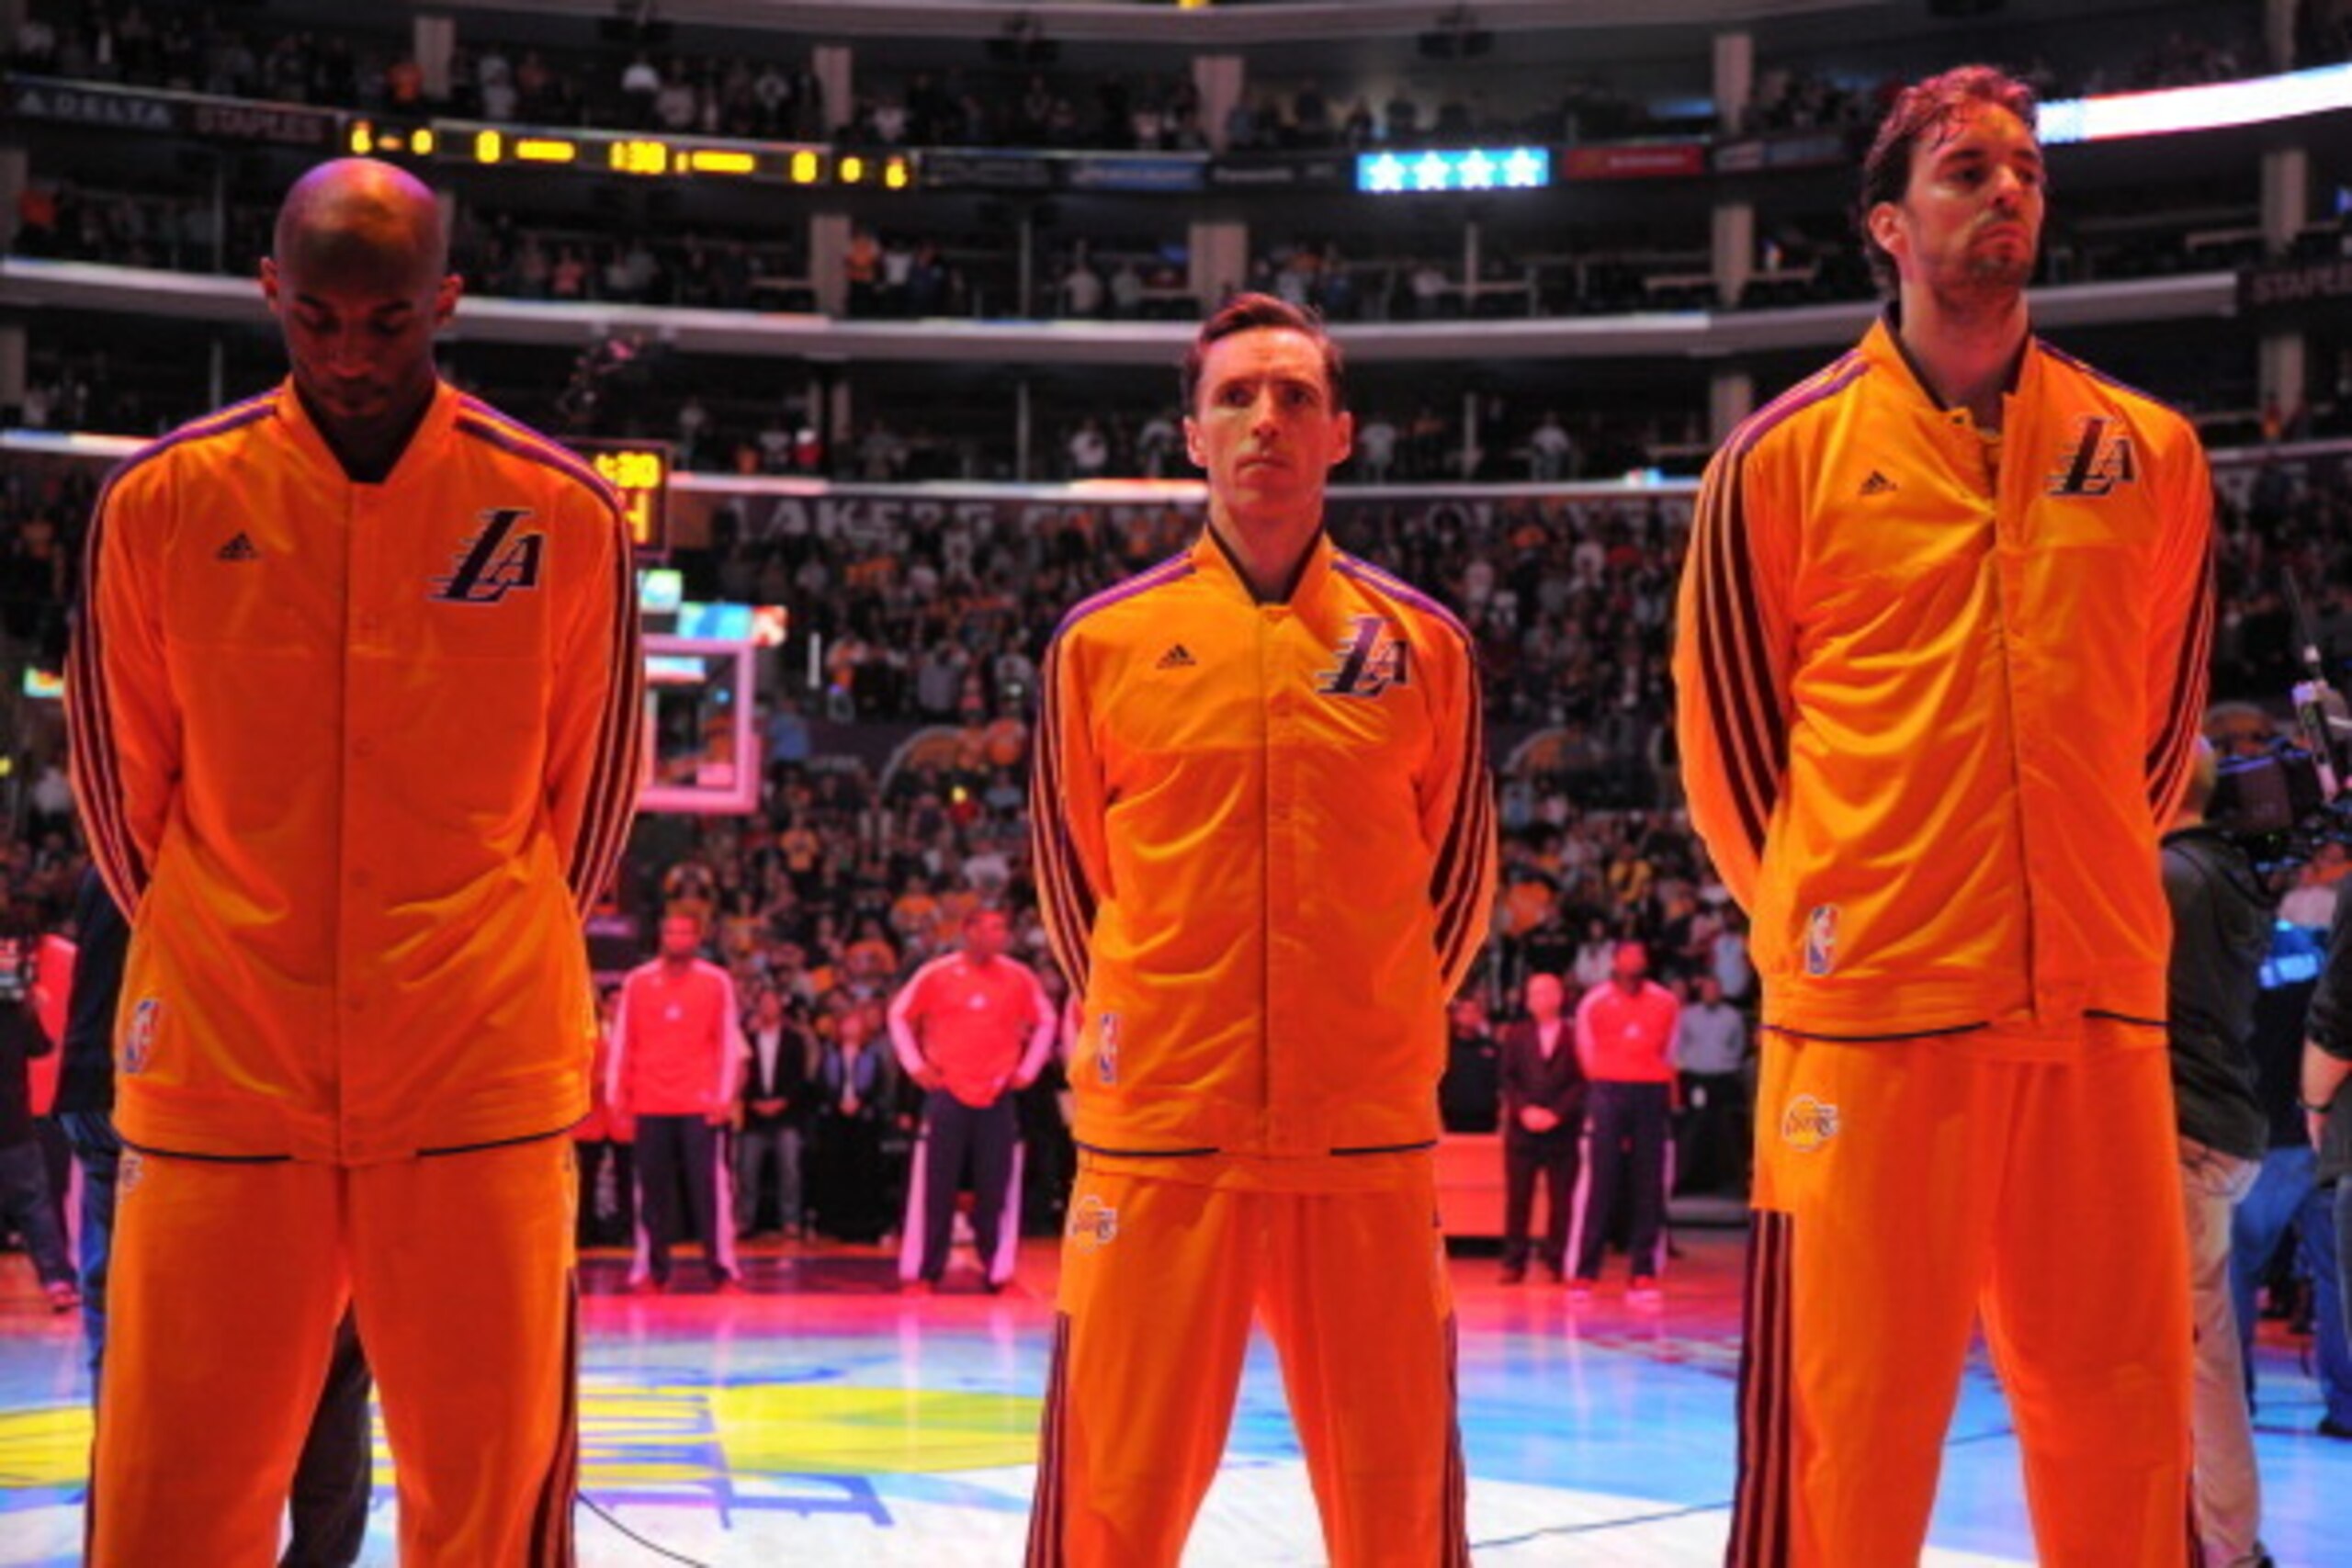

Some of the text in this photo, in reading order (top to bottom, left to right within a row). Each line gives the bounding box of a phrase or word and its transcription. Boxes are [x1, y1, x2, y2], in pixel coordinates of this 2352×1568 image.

[53, 92, 172, 130] DELTA
[2044, 414, 2143, 498] LA
[425, 508, 548, 606] LA
[1314, 614, 1412, 698] LA
